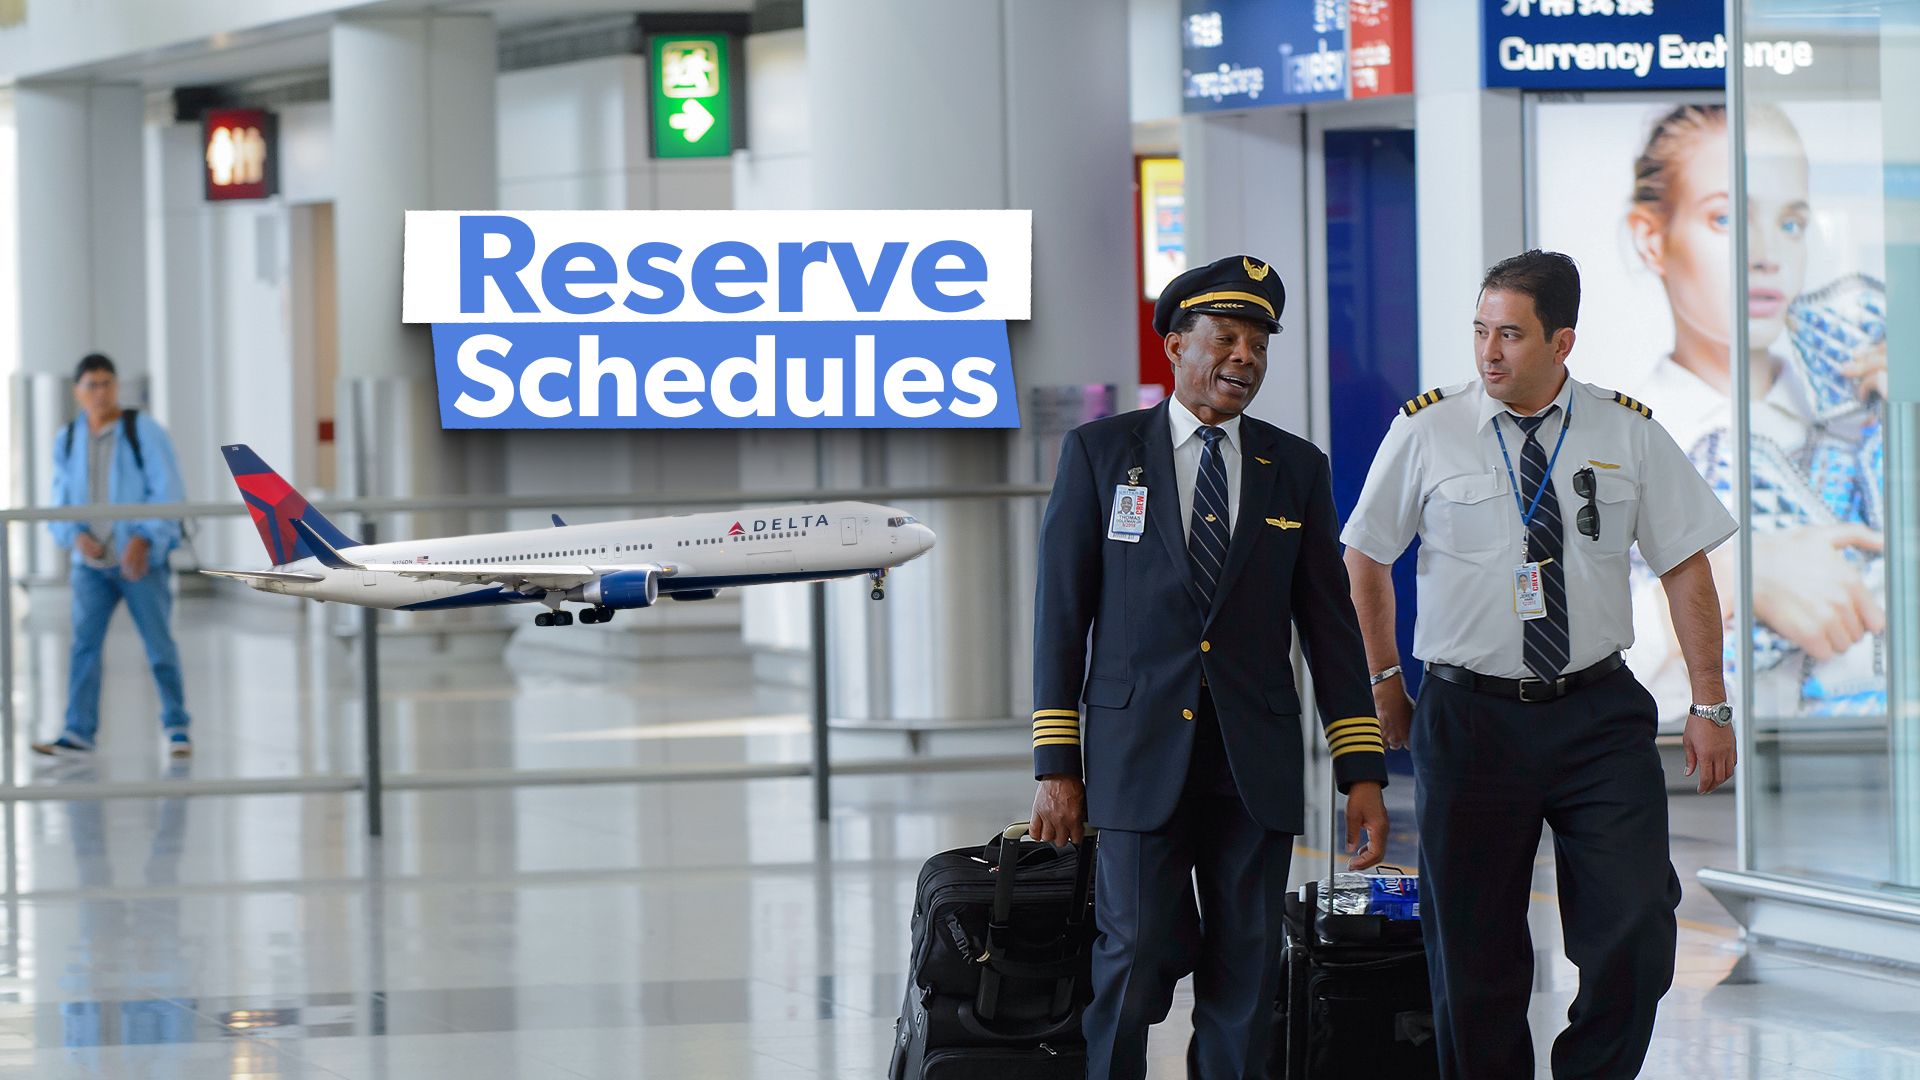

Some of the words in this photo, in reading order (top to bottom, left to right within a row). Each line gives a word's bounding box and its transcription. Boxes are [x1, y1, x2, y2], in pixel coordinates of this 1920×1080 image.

[1500, 36, 1654, 77] Currency
[1135, 496, 1144, 515] CREW
[753, 514, 829, 532] DELTA
[1530, 571, 1539, 591] CREW
